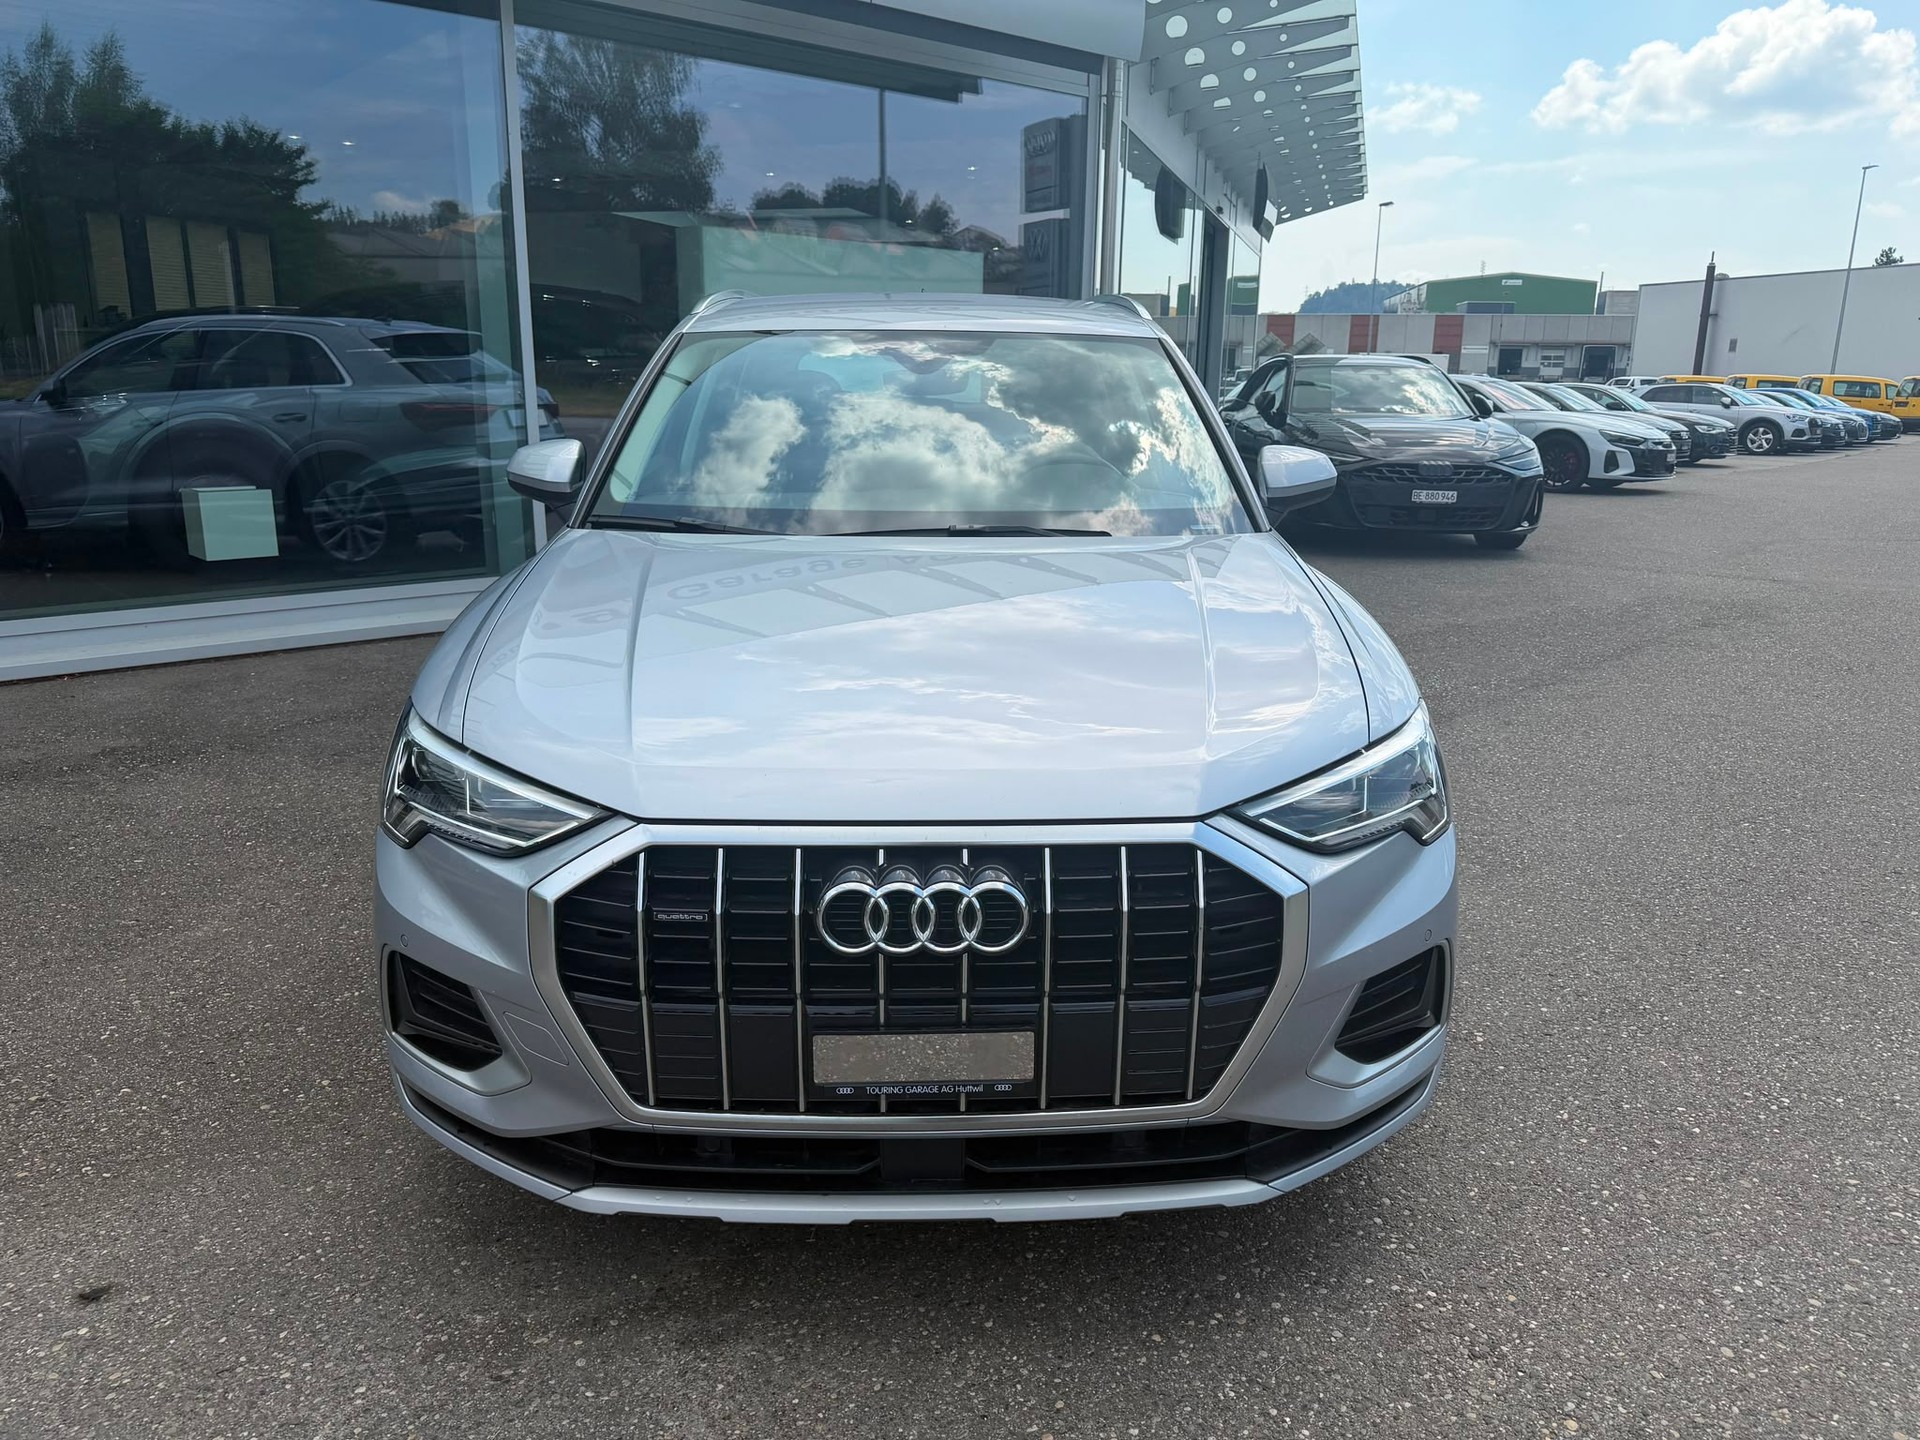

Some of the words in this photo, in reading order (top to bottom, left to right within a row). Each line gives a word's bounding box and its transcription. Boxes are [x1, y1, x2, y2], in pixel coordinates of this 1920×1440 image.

[866, 1086, 903, 1094] TOURING
[904, 1085, 939, 1094] GARAGE
[940, 1085, 954, 1093] AG
[955, 1084, 984, 1093] Huttwil
